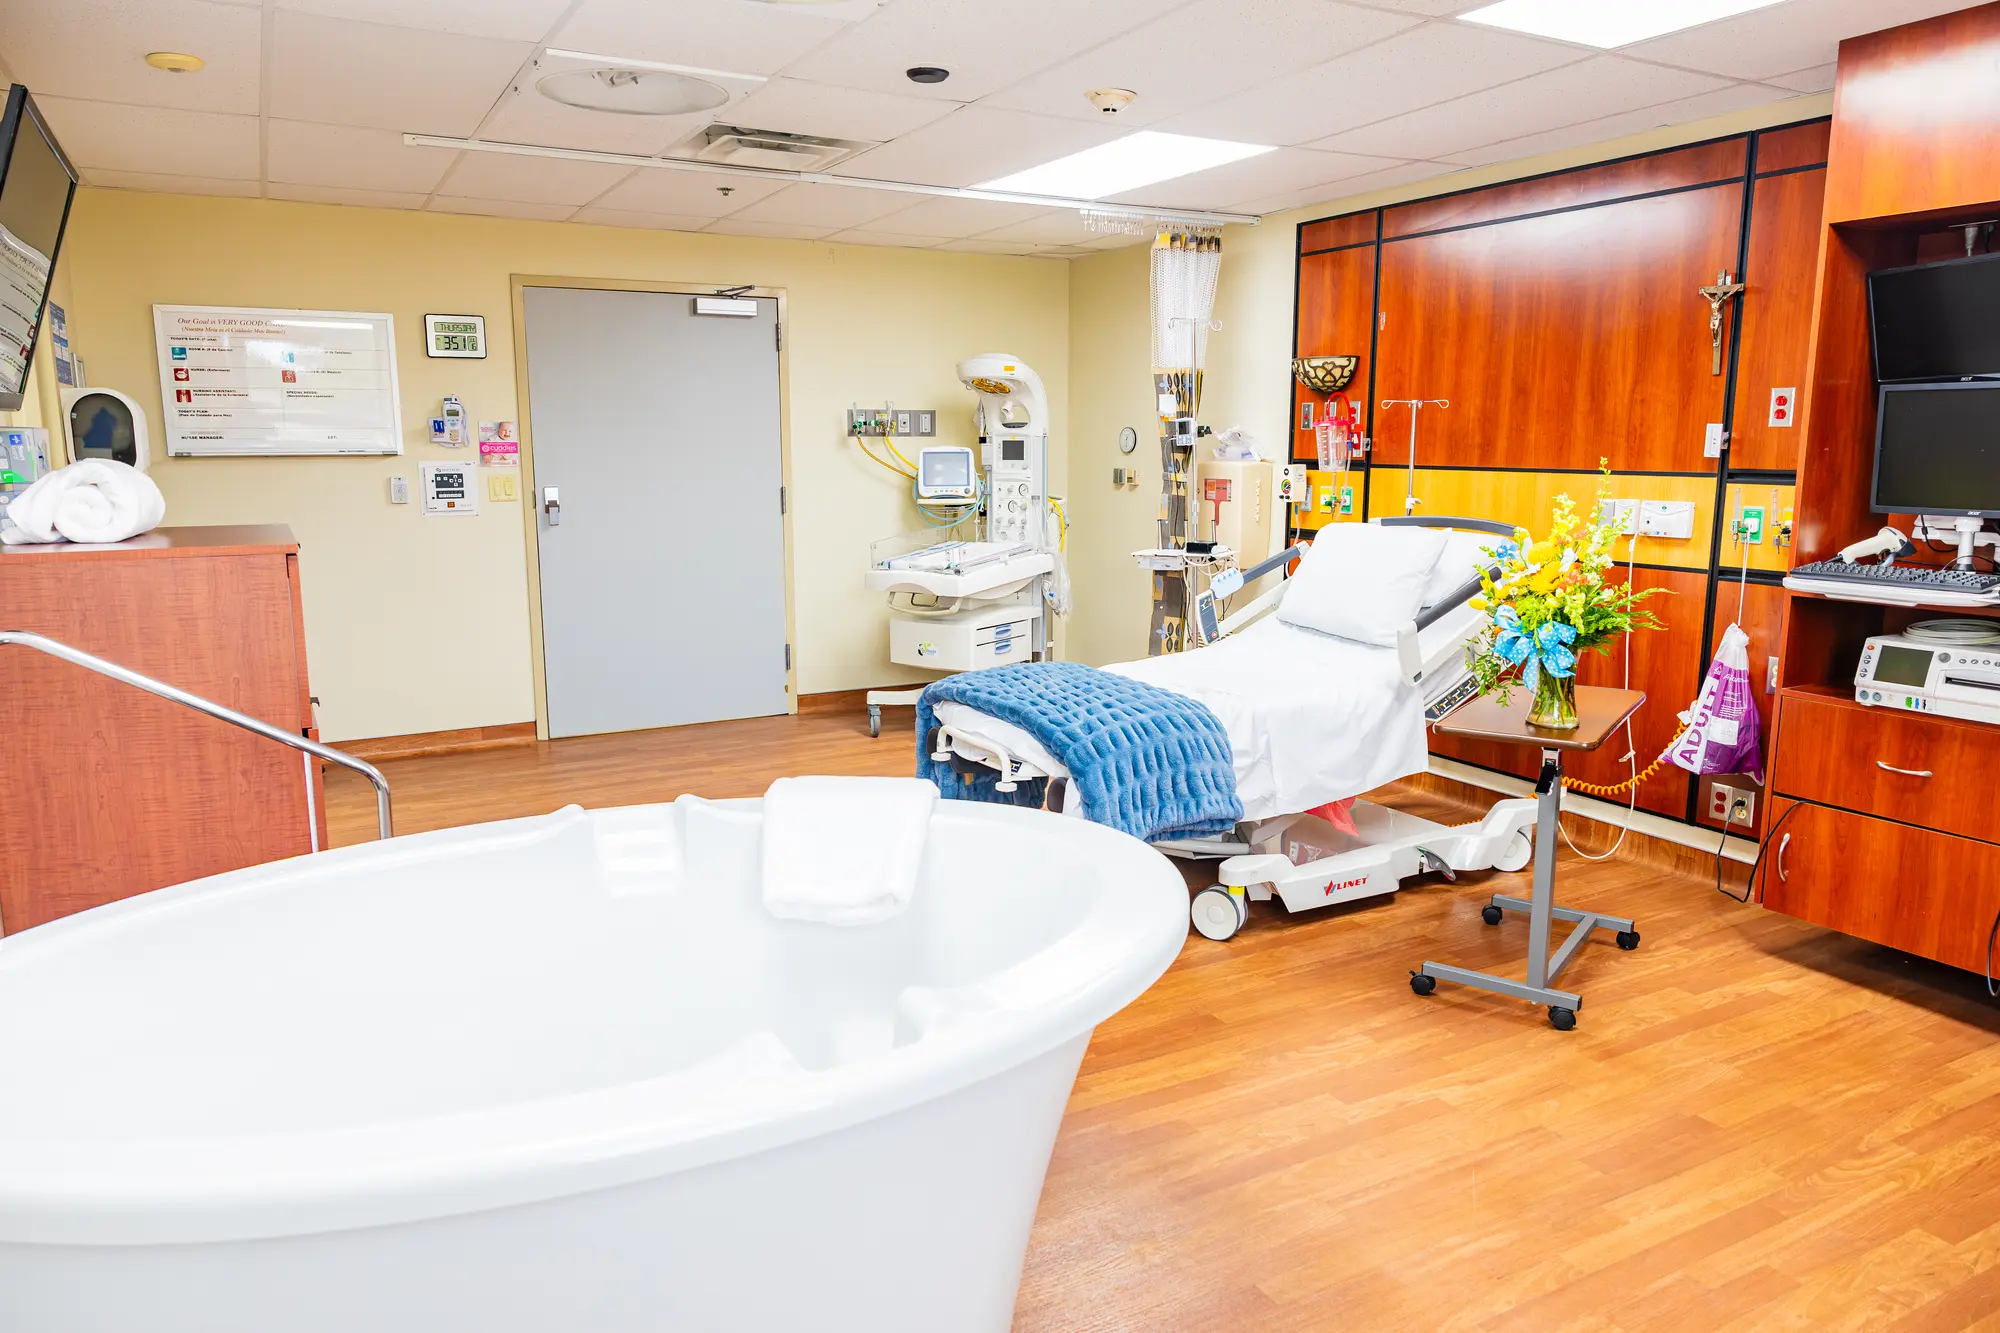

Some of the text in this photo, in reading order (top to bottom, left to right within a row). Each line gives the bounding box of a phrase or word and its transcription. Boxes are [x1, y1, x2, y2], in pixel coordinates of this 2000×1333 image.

[192, 317, 210, 325] Goal
[217, 318, 239, 326] VERY
[490, 444, 517, 452] cuddles
[1679, 685, 1718, 765] ADULT
[1336, 877, 1367, 891] LINET
